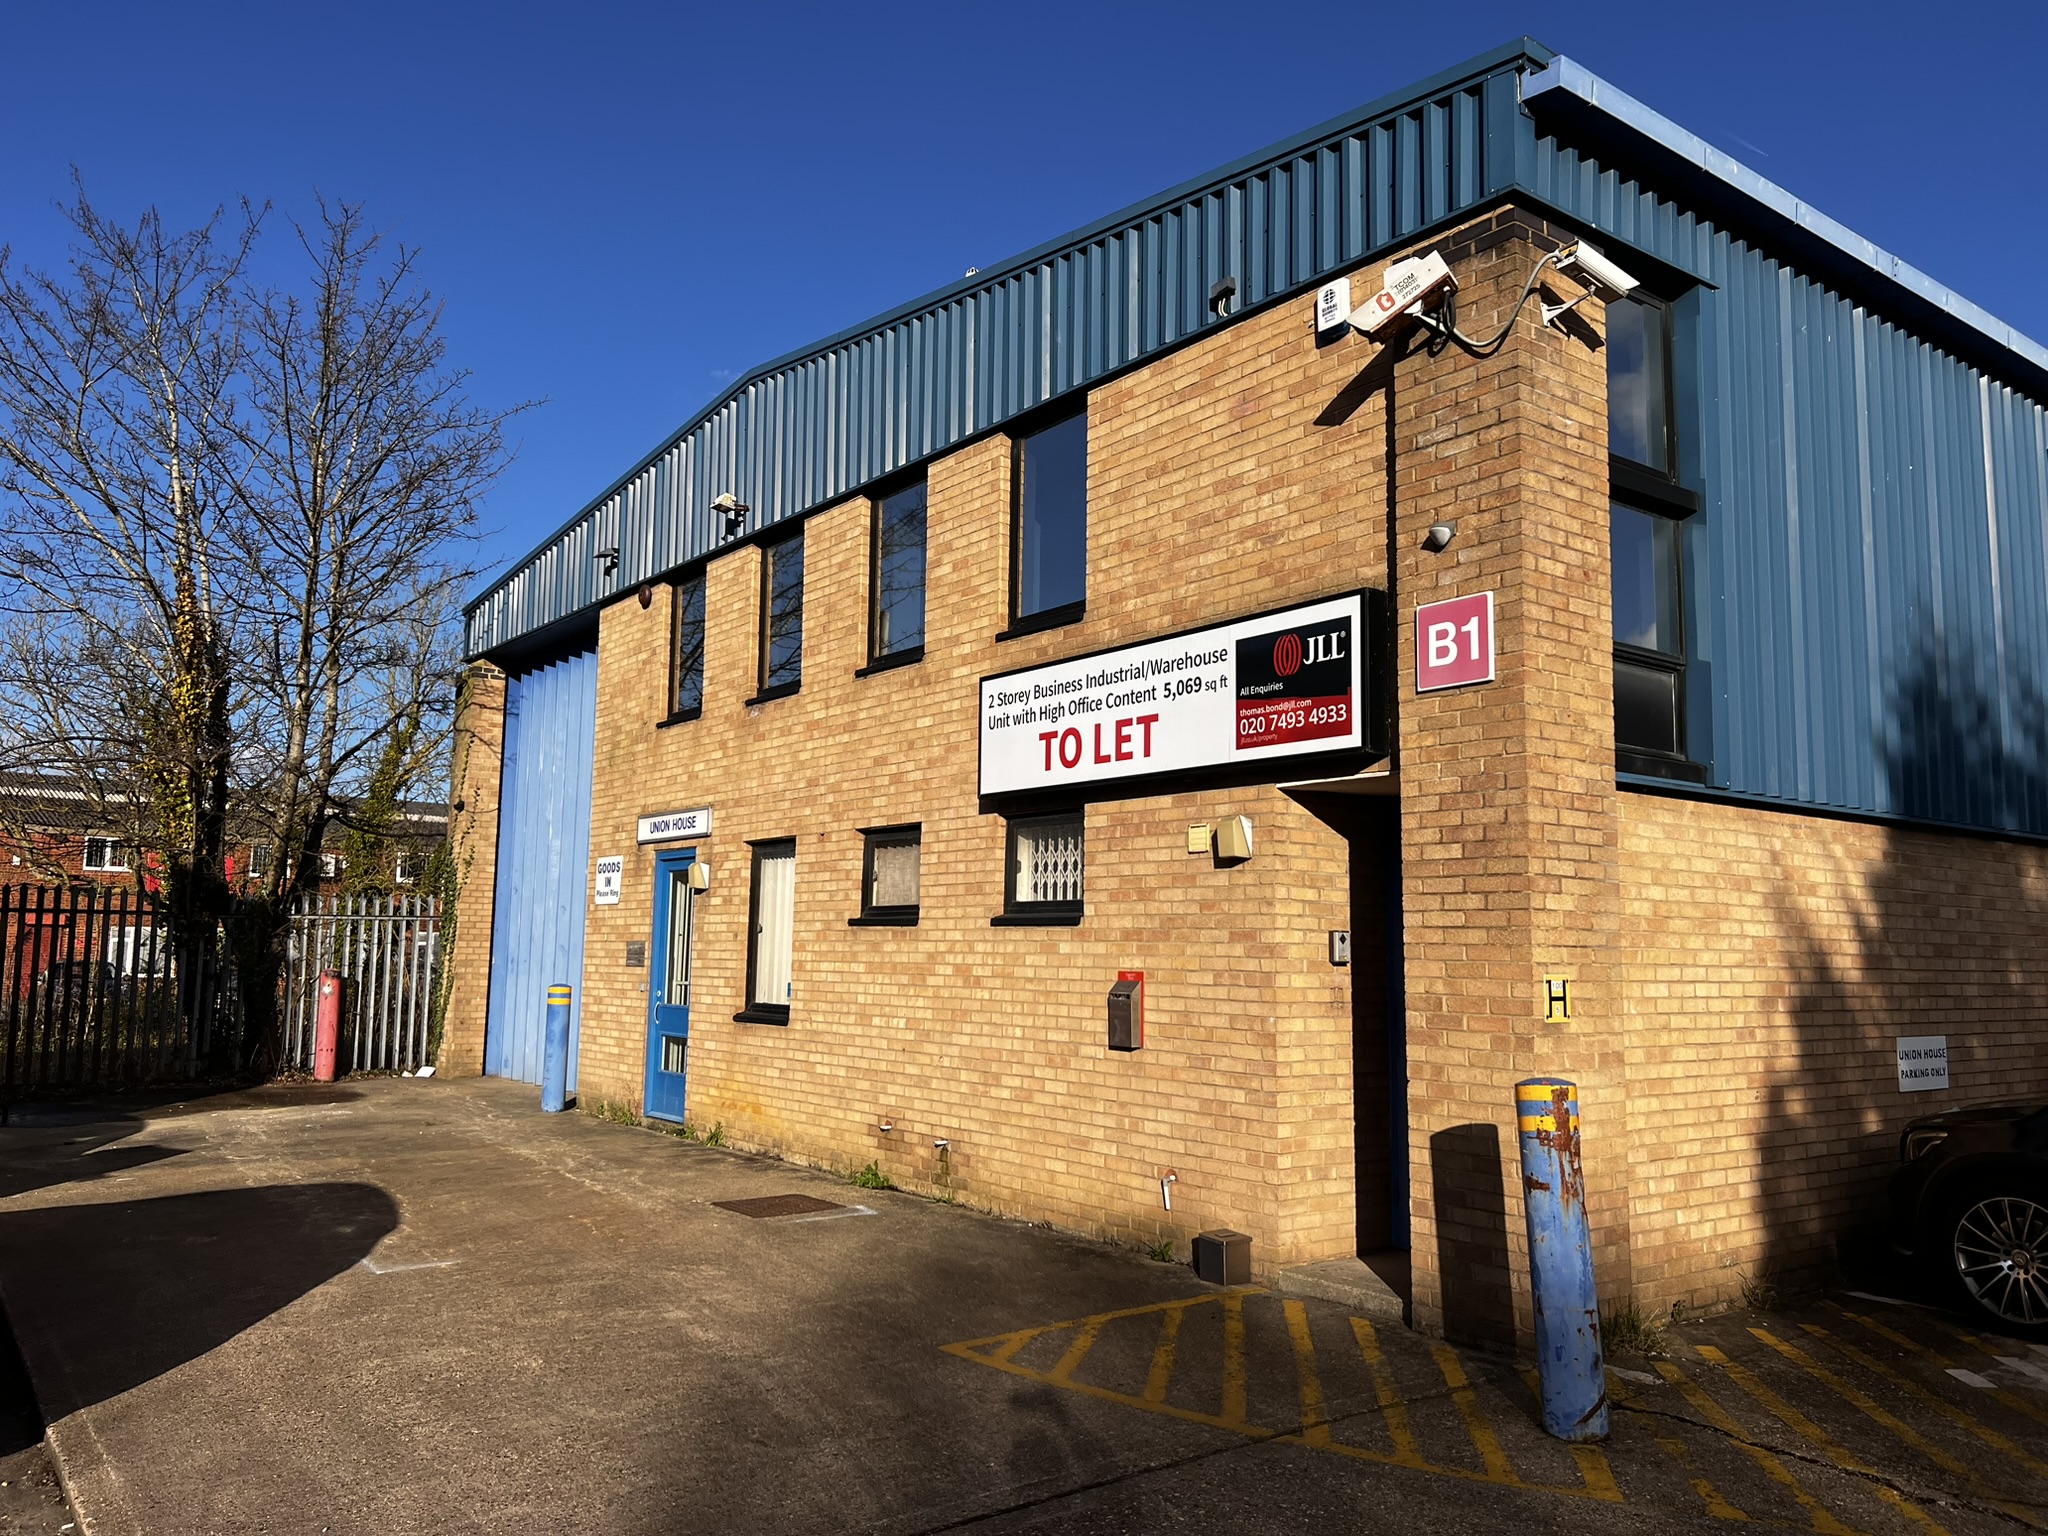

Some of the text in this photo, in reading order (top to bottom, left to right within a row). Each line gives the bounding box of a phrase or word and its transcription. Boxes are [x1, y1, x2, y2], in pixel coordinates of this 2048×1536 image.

[1428, 615, 1480, 668] B1
[988, 648, 1228, 709] 2 Storey Business Industrial/Warehouse
[1240, 682, 1284, 696] All Enquiries
[988, 674, 1228, 730] Unit with High Office Content 5,069 sq ft
[1240, 699, 1312, 717] thomas.bond@jll.com
[1240, 704, 1347, 735] 020 7493 4933
[1039, 713, 1159, 771] TO LET
[650, 815, 697, 834] UNION HOUSE
[598, 861, 621, 874] GOODS
[604, 876, 612, 888] IN
[596, 889, 619, 898] Please Ring
[1548, 979, 1567, 1017] H
[1899, 1048, 1946, 1060] UNION HOUSE
[1901, 1066, 1947, 1079] PARKING ONLY
